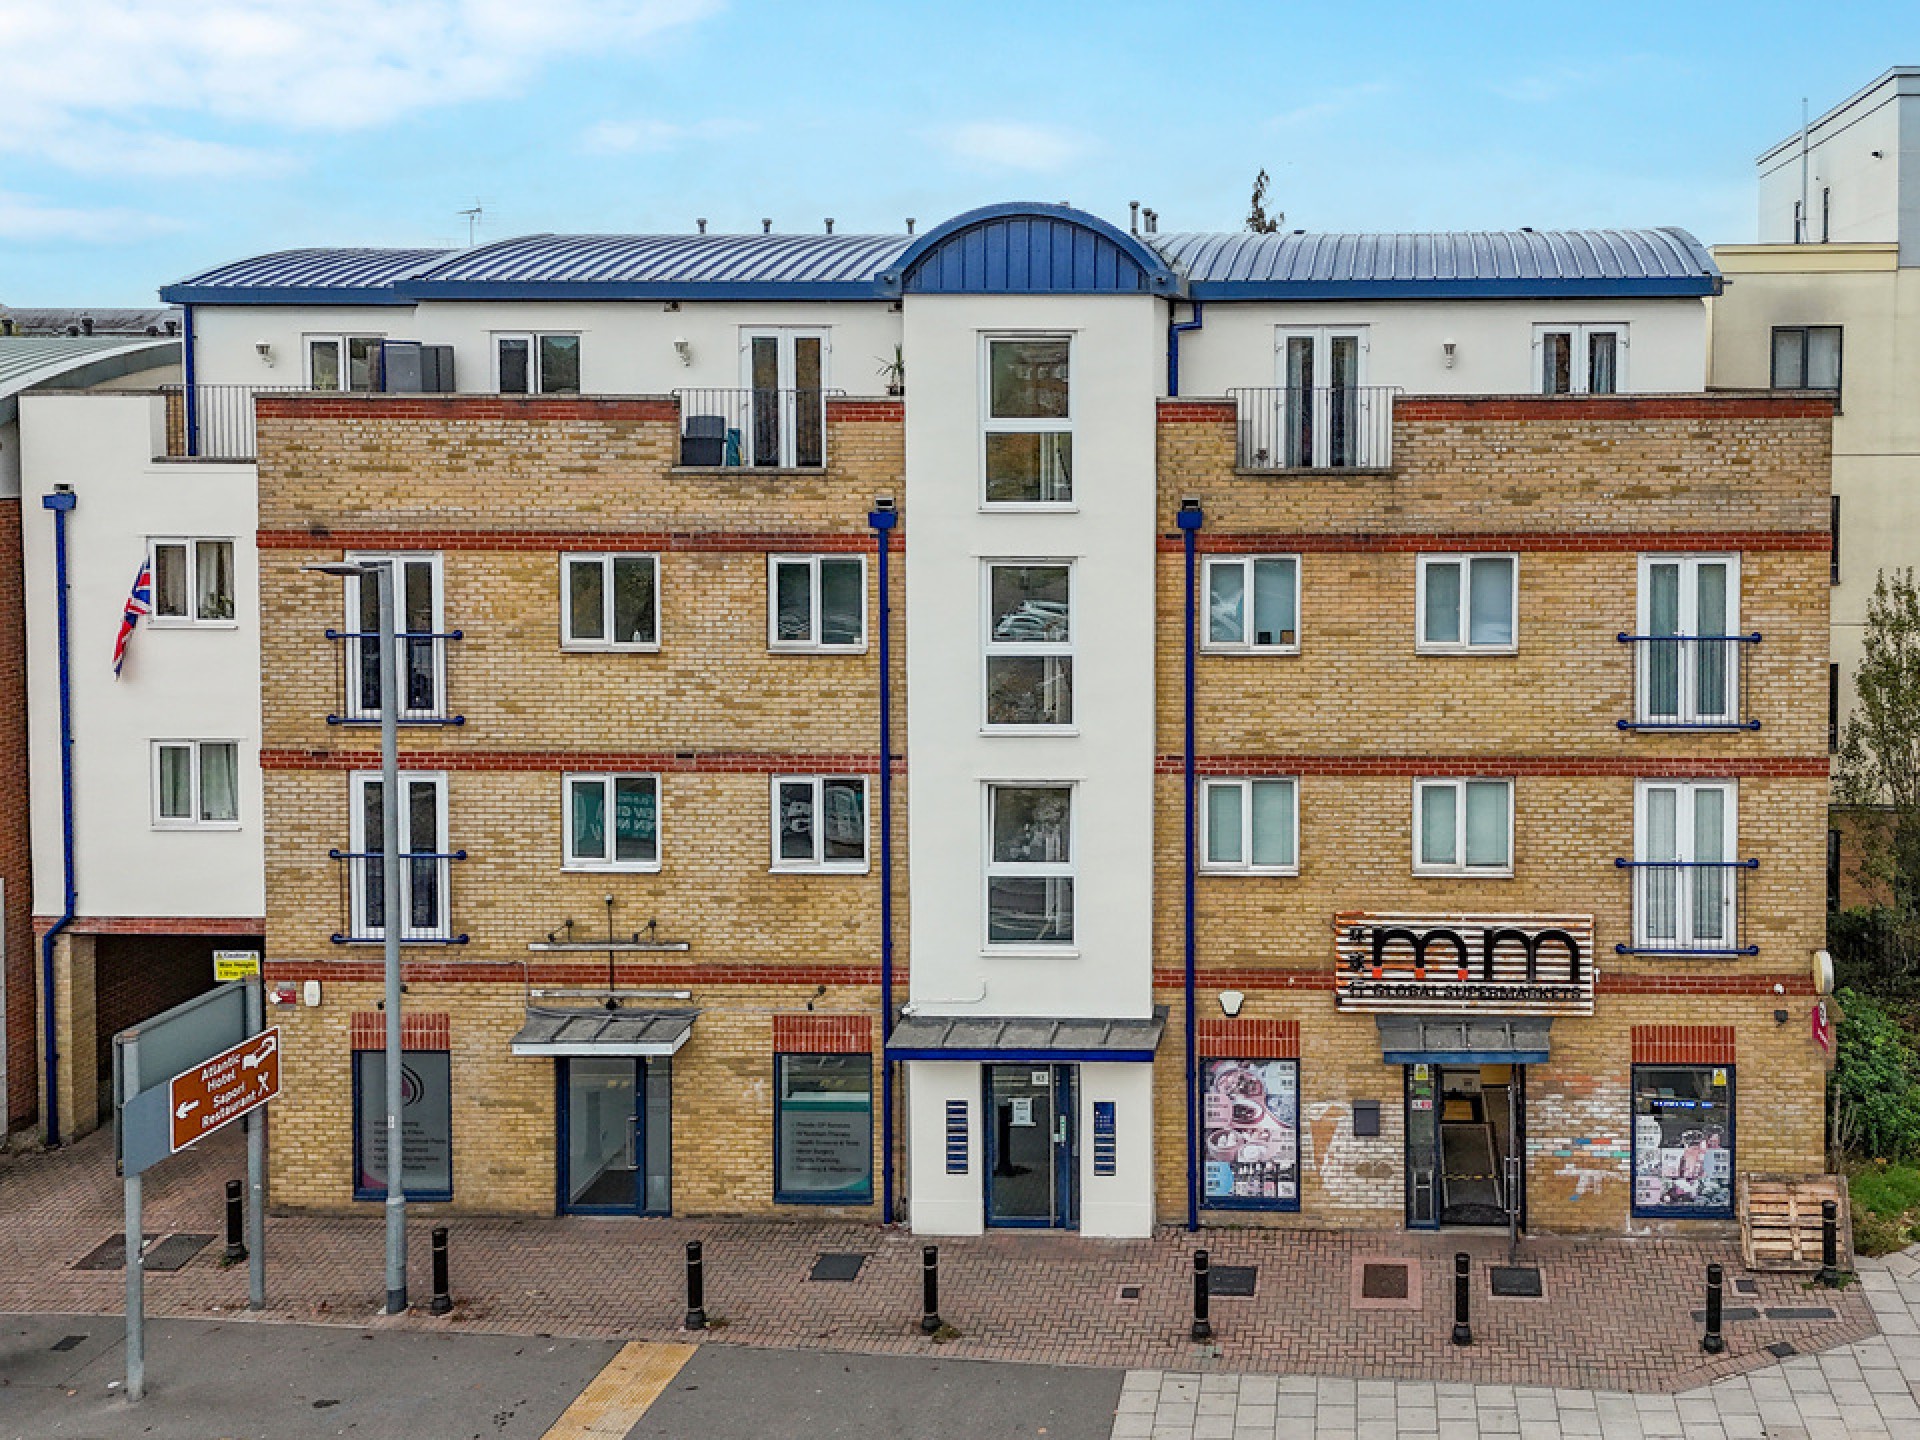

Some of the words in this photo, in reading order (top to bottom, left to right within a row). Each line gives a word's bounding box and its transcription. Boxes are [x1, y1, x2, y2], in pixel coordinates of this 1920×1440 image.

[1373, 984, 1437, 999] GLOBAL
[201, 1053, 241, 1081] Atlantic
[207, 1068, 236, 1092] Hotel
[201, 1089, 256, 1129] Restaurant
